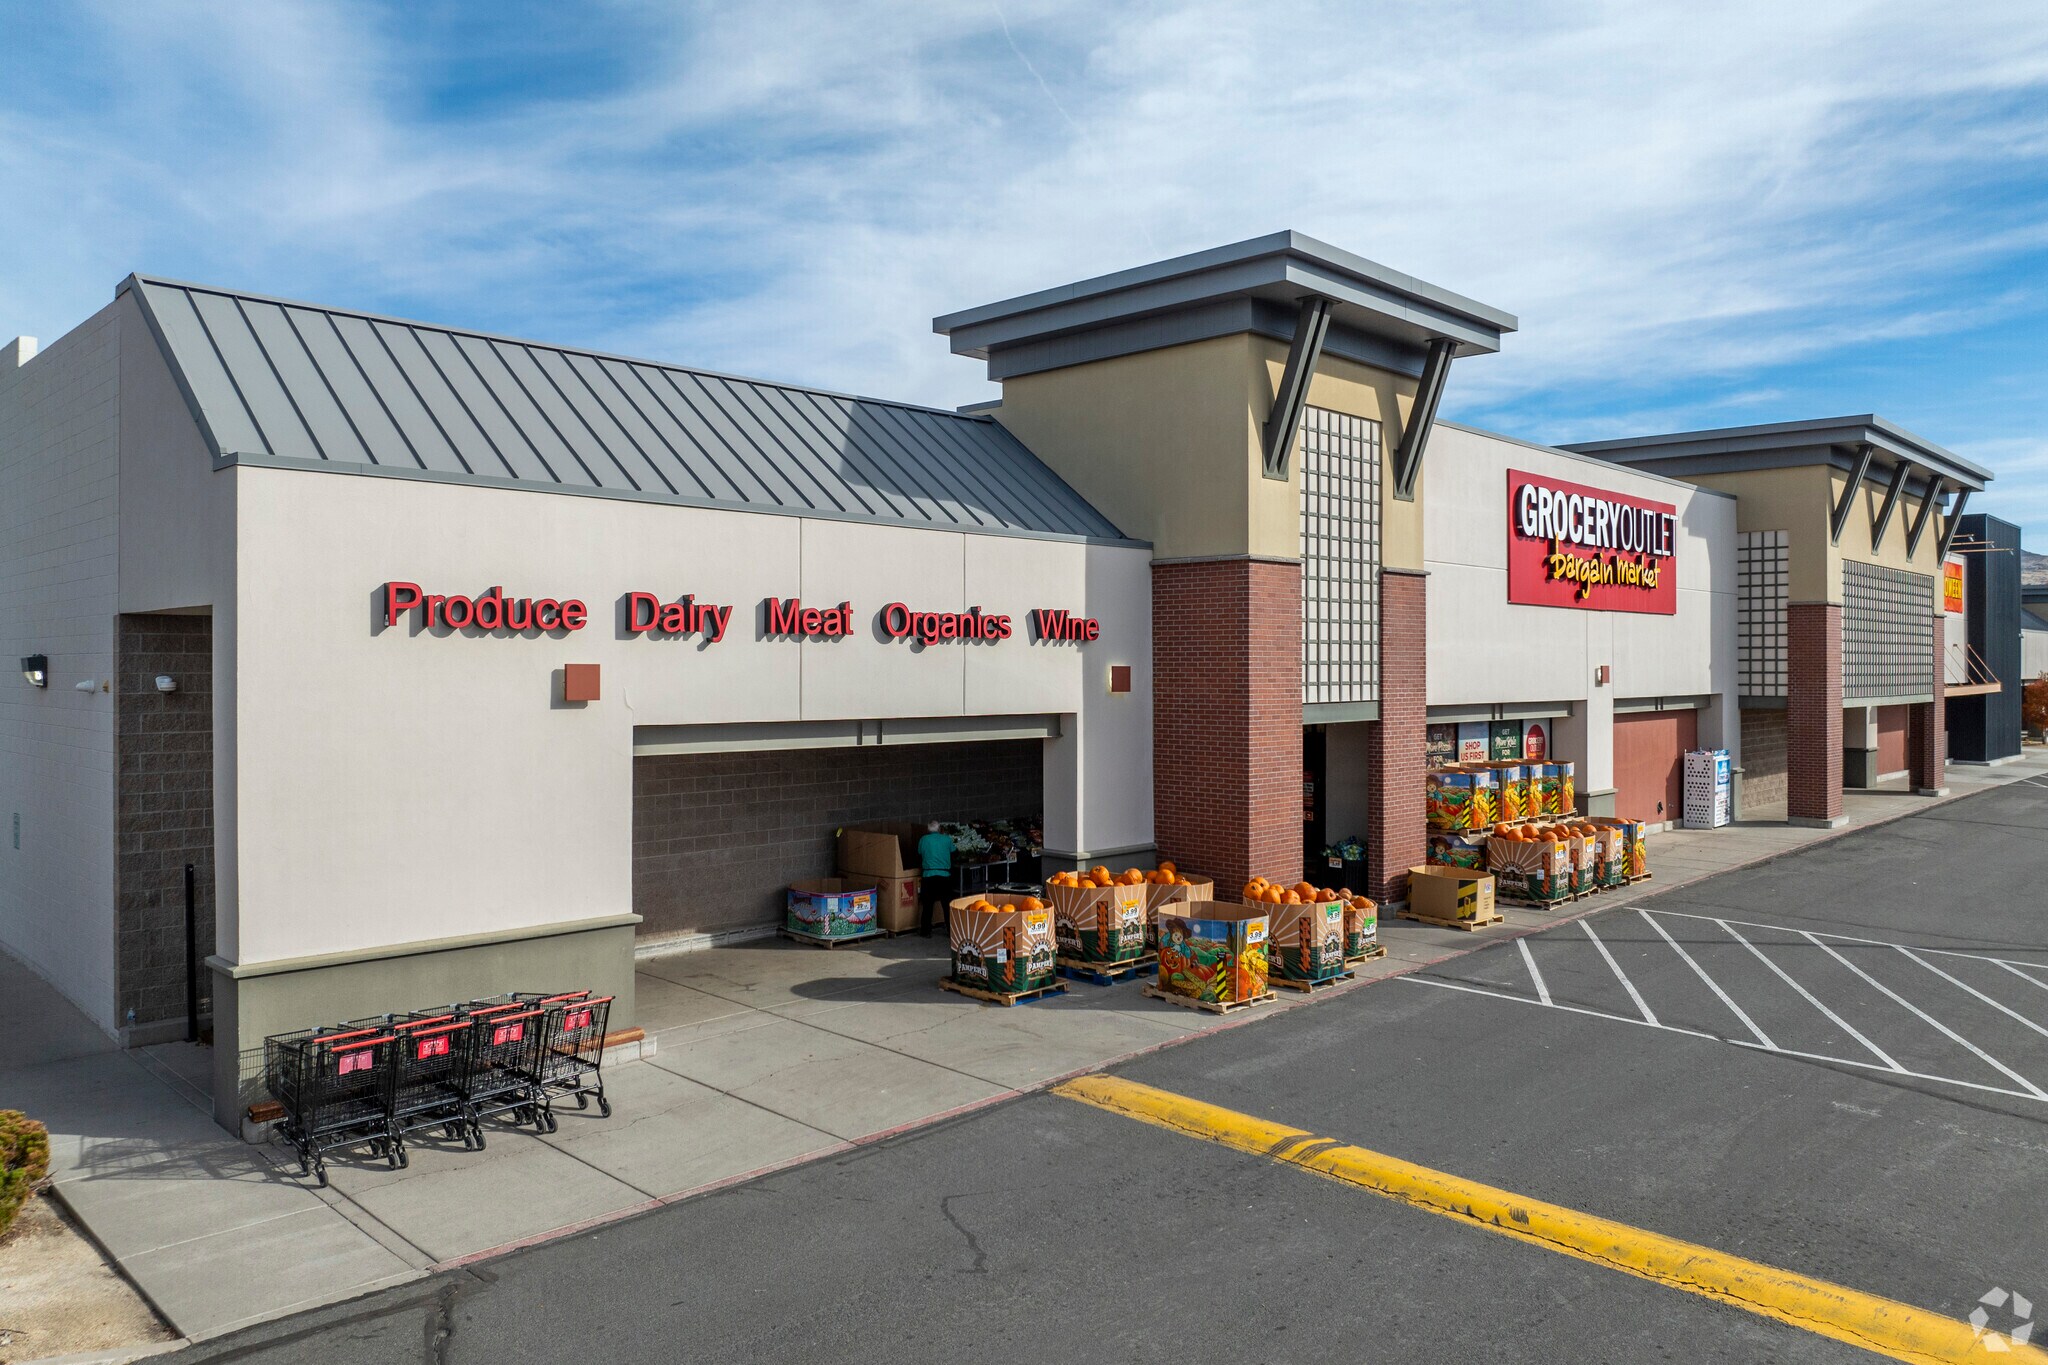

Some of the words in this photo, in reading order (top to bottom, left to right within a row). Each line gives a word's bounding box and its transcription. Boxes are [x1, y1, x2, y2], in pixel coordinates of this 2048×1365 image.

[385, 581, 588, 631] Produce
[629, 592, 734, 643] Dairy
[768, 597, 854, 636] Meat
[883, 602, 1013, 646] Organics
[1036, 608, 1101, 641] Wine
[1464, 741, 1481, 751] SHOP
[1460, 752, 1469, 761] US
[1469, 750, 1485, 760] FIRST
[1031, 923, 1046, 931] 3.99
